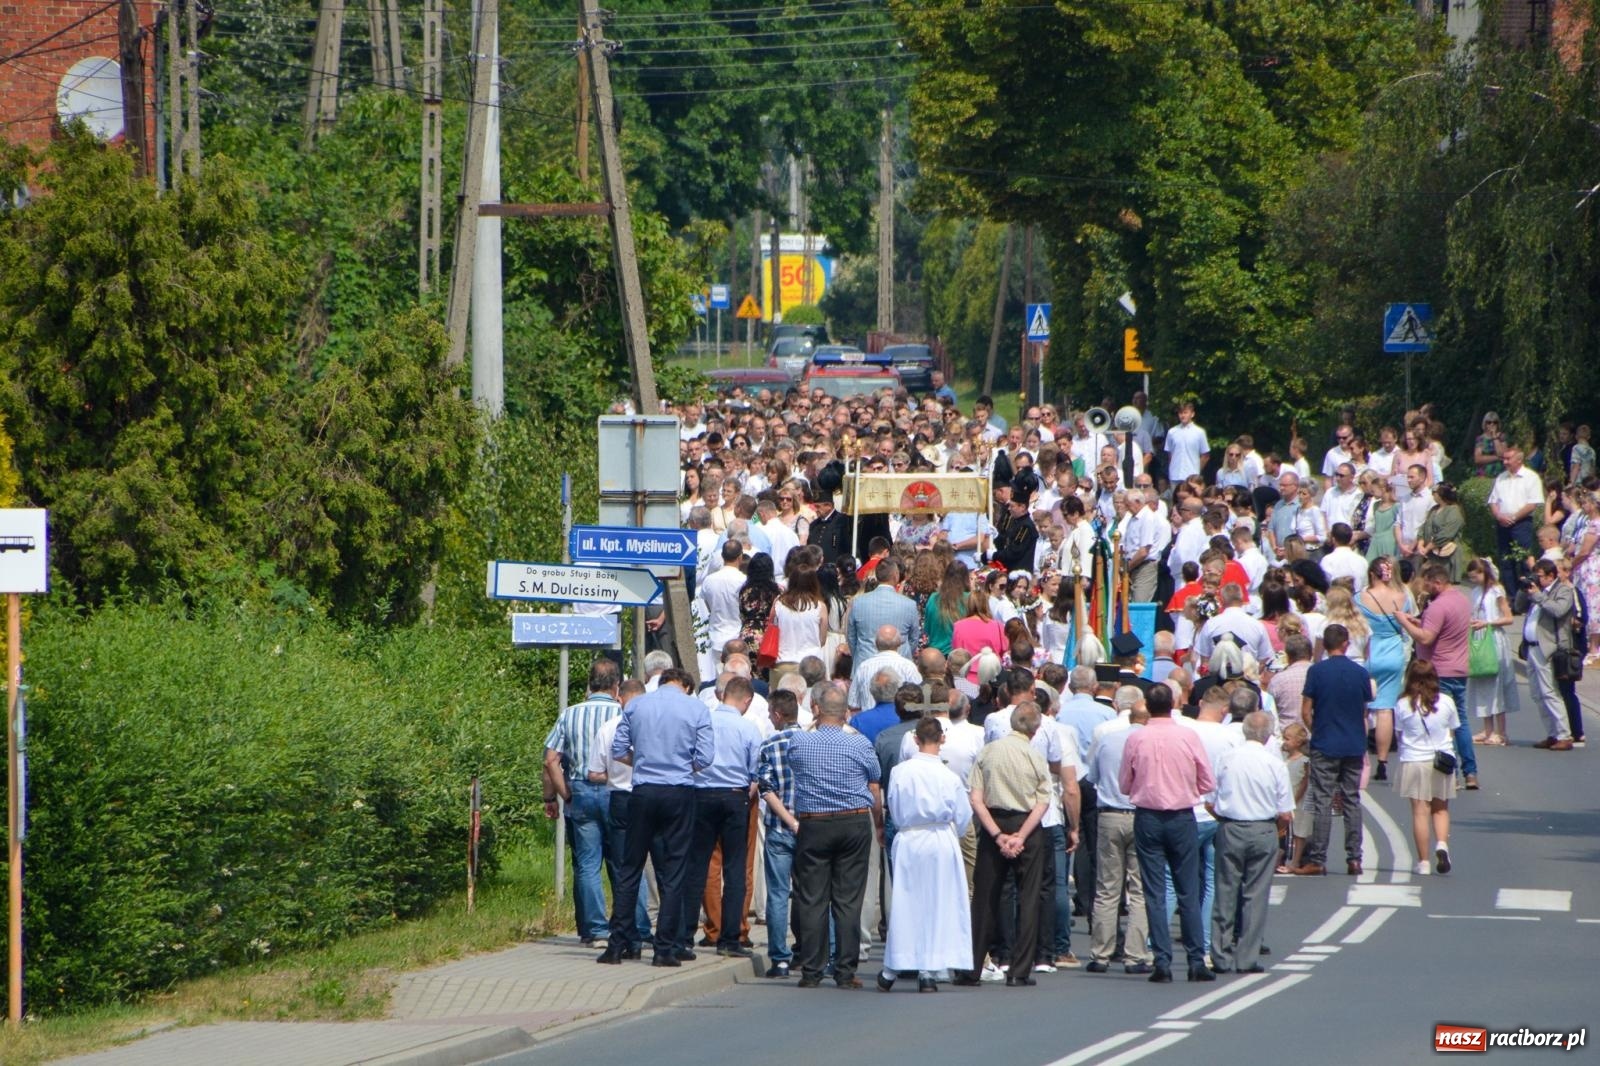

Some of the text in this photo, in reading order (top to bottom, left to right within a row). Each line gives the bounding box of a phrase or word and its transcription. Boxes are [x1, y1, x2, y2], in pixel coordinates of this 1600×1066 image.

[582, 537, 682, 555] ul. Kpt. Myśliwca
[526, 567, 618, 581] Do grobu Sługi Bożej
[518, 580, 619, 601] S. M. Dulcissimy
